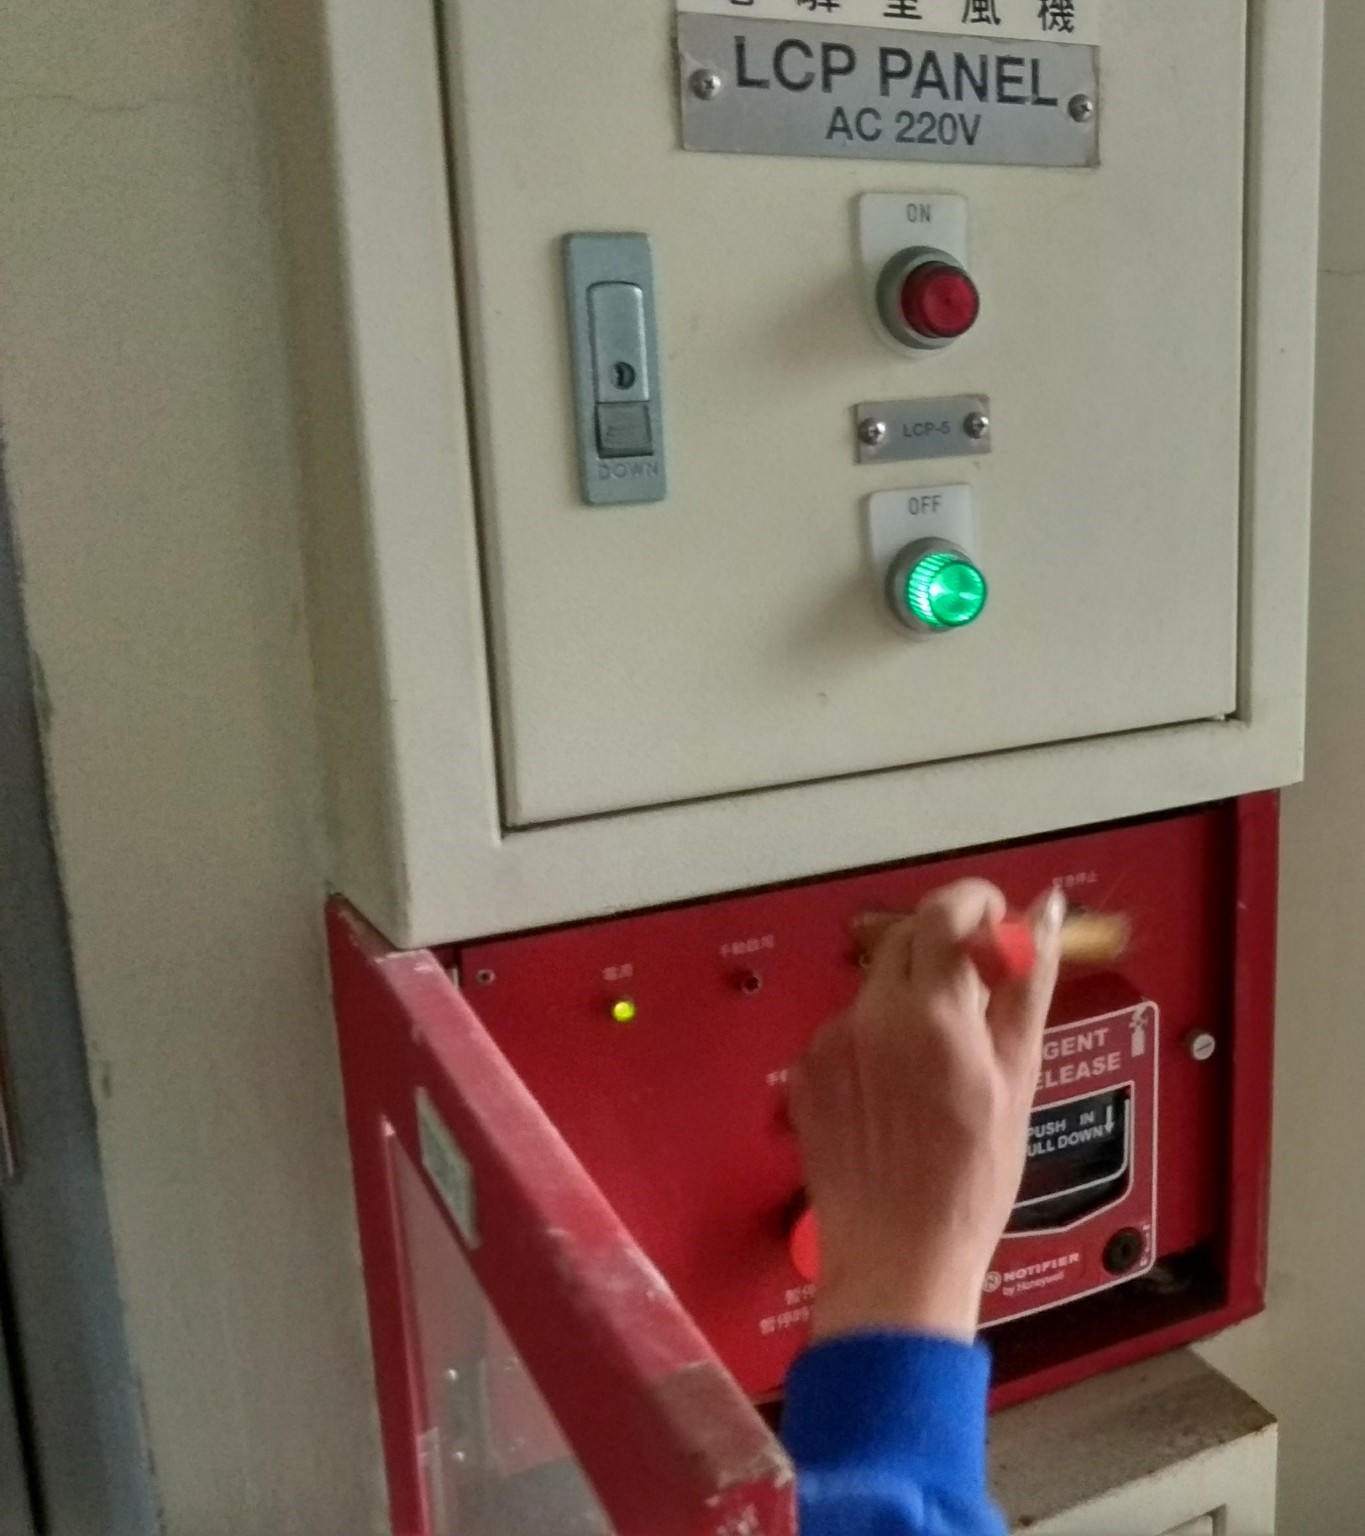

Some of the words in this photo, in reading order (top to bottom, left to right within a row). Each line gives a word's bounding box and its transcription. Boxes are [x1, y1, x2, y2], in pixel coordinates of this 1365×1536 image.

[733, 35, 857, 94] LCP
[879, 46, 1059, 107] PANEL
[825, 106, 883, 142] AC
[894, 110, 981, 146] 220V
[906, 202, 931, 223] ON
[903, 421, 951, 438] LCP-5
[598, 461, 659, 480] DOWN
[908, 495, 942, 516] OFF
[1042, 1027, 1109, 1060] GENT
[1036, 1051, 1121, 1090] ELEASE
[1080, 1110, 1095, 1126] IN
[1027, 1138, 1055, 1157] ULL
[1057, 1125, 1104, 1149] DOWN
[1003, 1252, 1080, 1282] NOTIFIER
[1016, 1271, 1065, 1292] Honeywell
